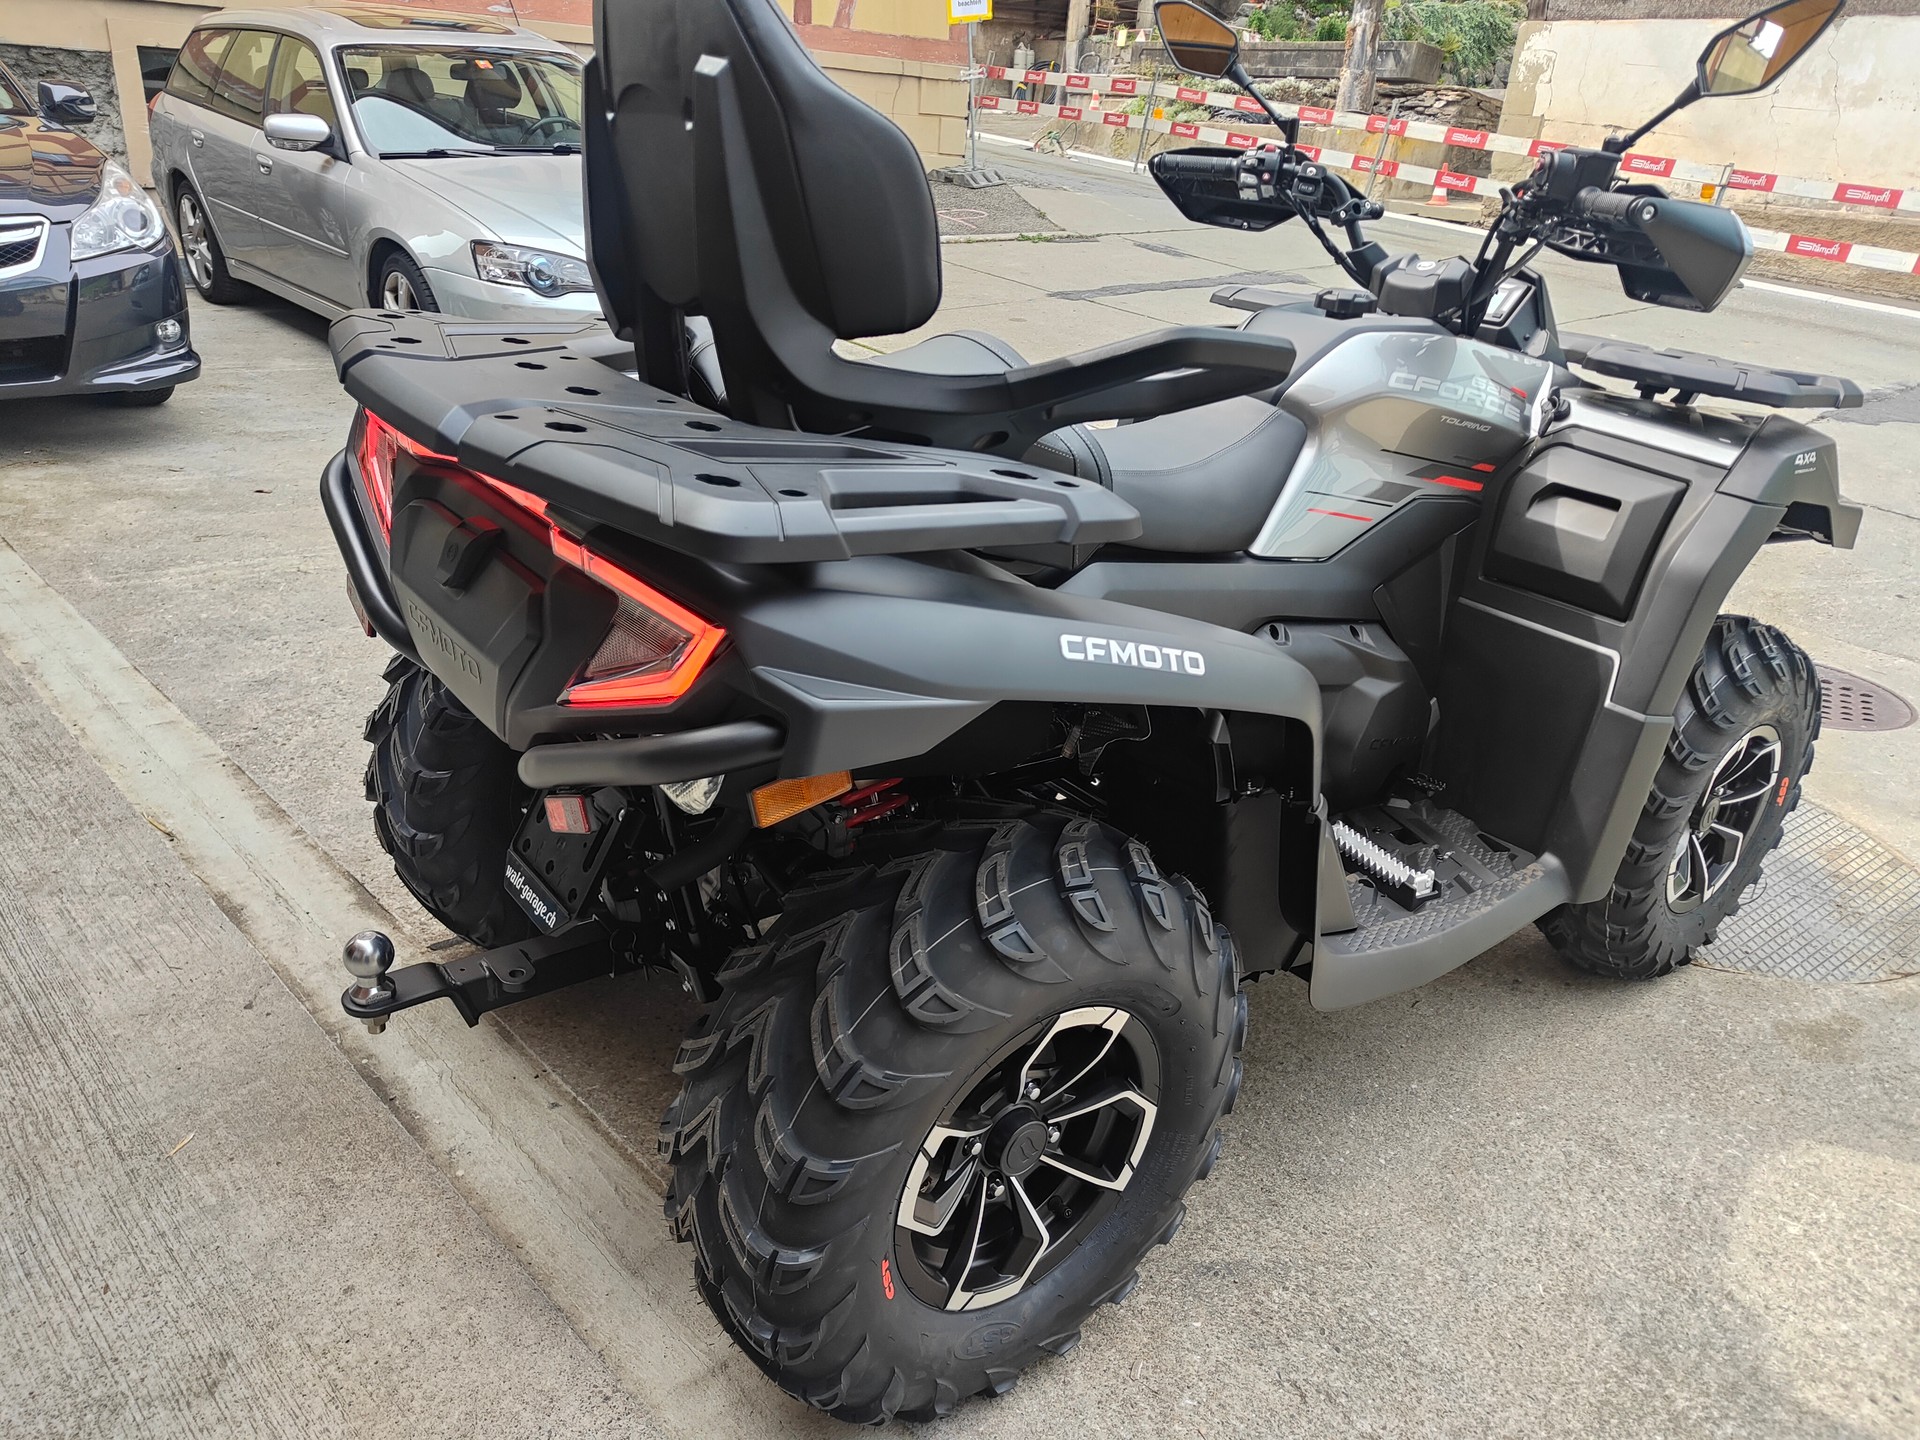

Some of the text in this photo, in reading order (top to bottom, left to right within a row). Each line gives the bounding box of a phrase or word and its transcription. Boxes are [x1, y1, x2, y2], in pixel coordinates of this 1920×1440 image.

[1388, 371, 1521, 423] CFORCE
[1060, 634, 1206, 676] CFMOTO
[505, 864, 557, 929] wald-garage.ch
[881, 1259, 895, 1300] CST
